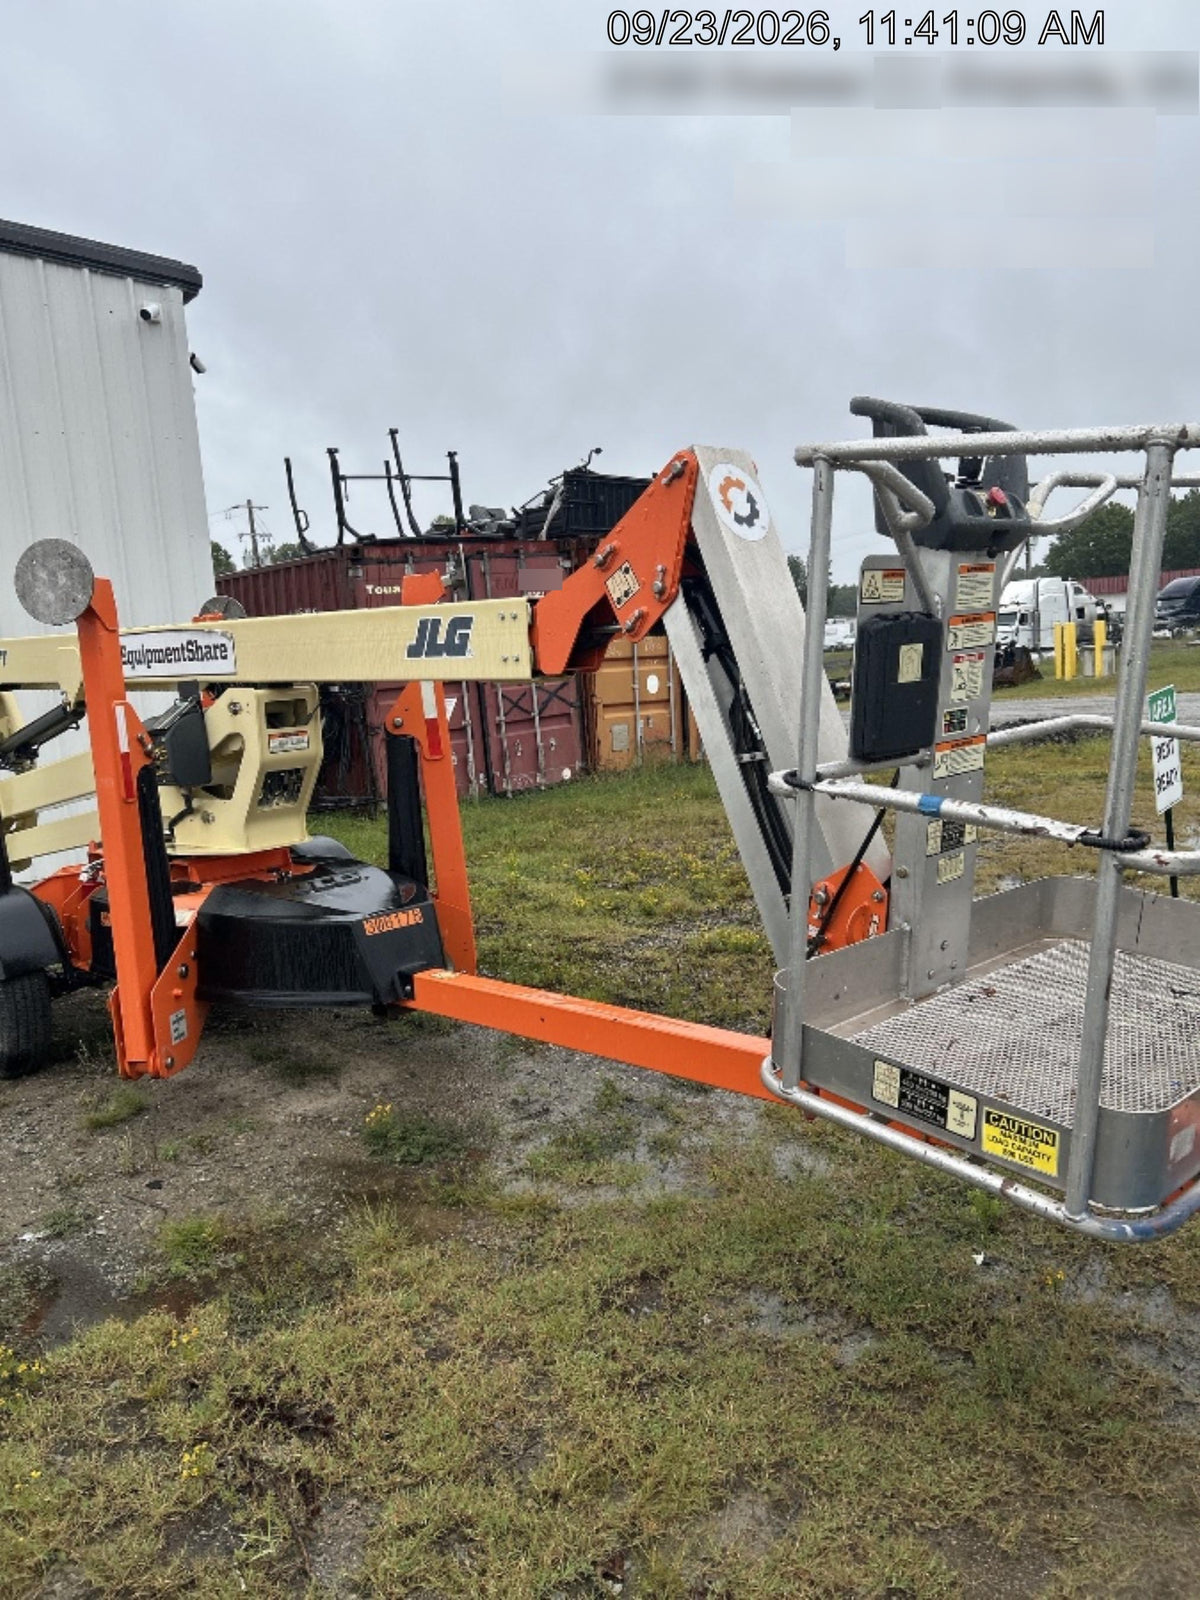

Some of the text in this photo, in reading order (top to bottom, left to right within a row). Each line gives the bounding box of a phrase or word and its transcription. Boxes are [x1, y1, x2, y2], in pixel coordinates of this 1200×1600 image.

[120, 640, 228, 669] EquipmentShare
[406, 617, 474, 659] JLG
[989, 1113, 1055, 1146] CAUTION
